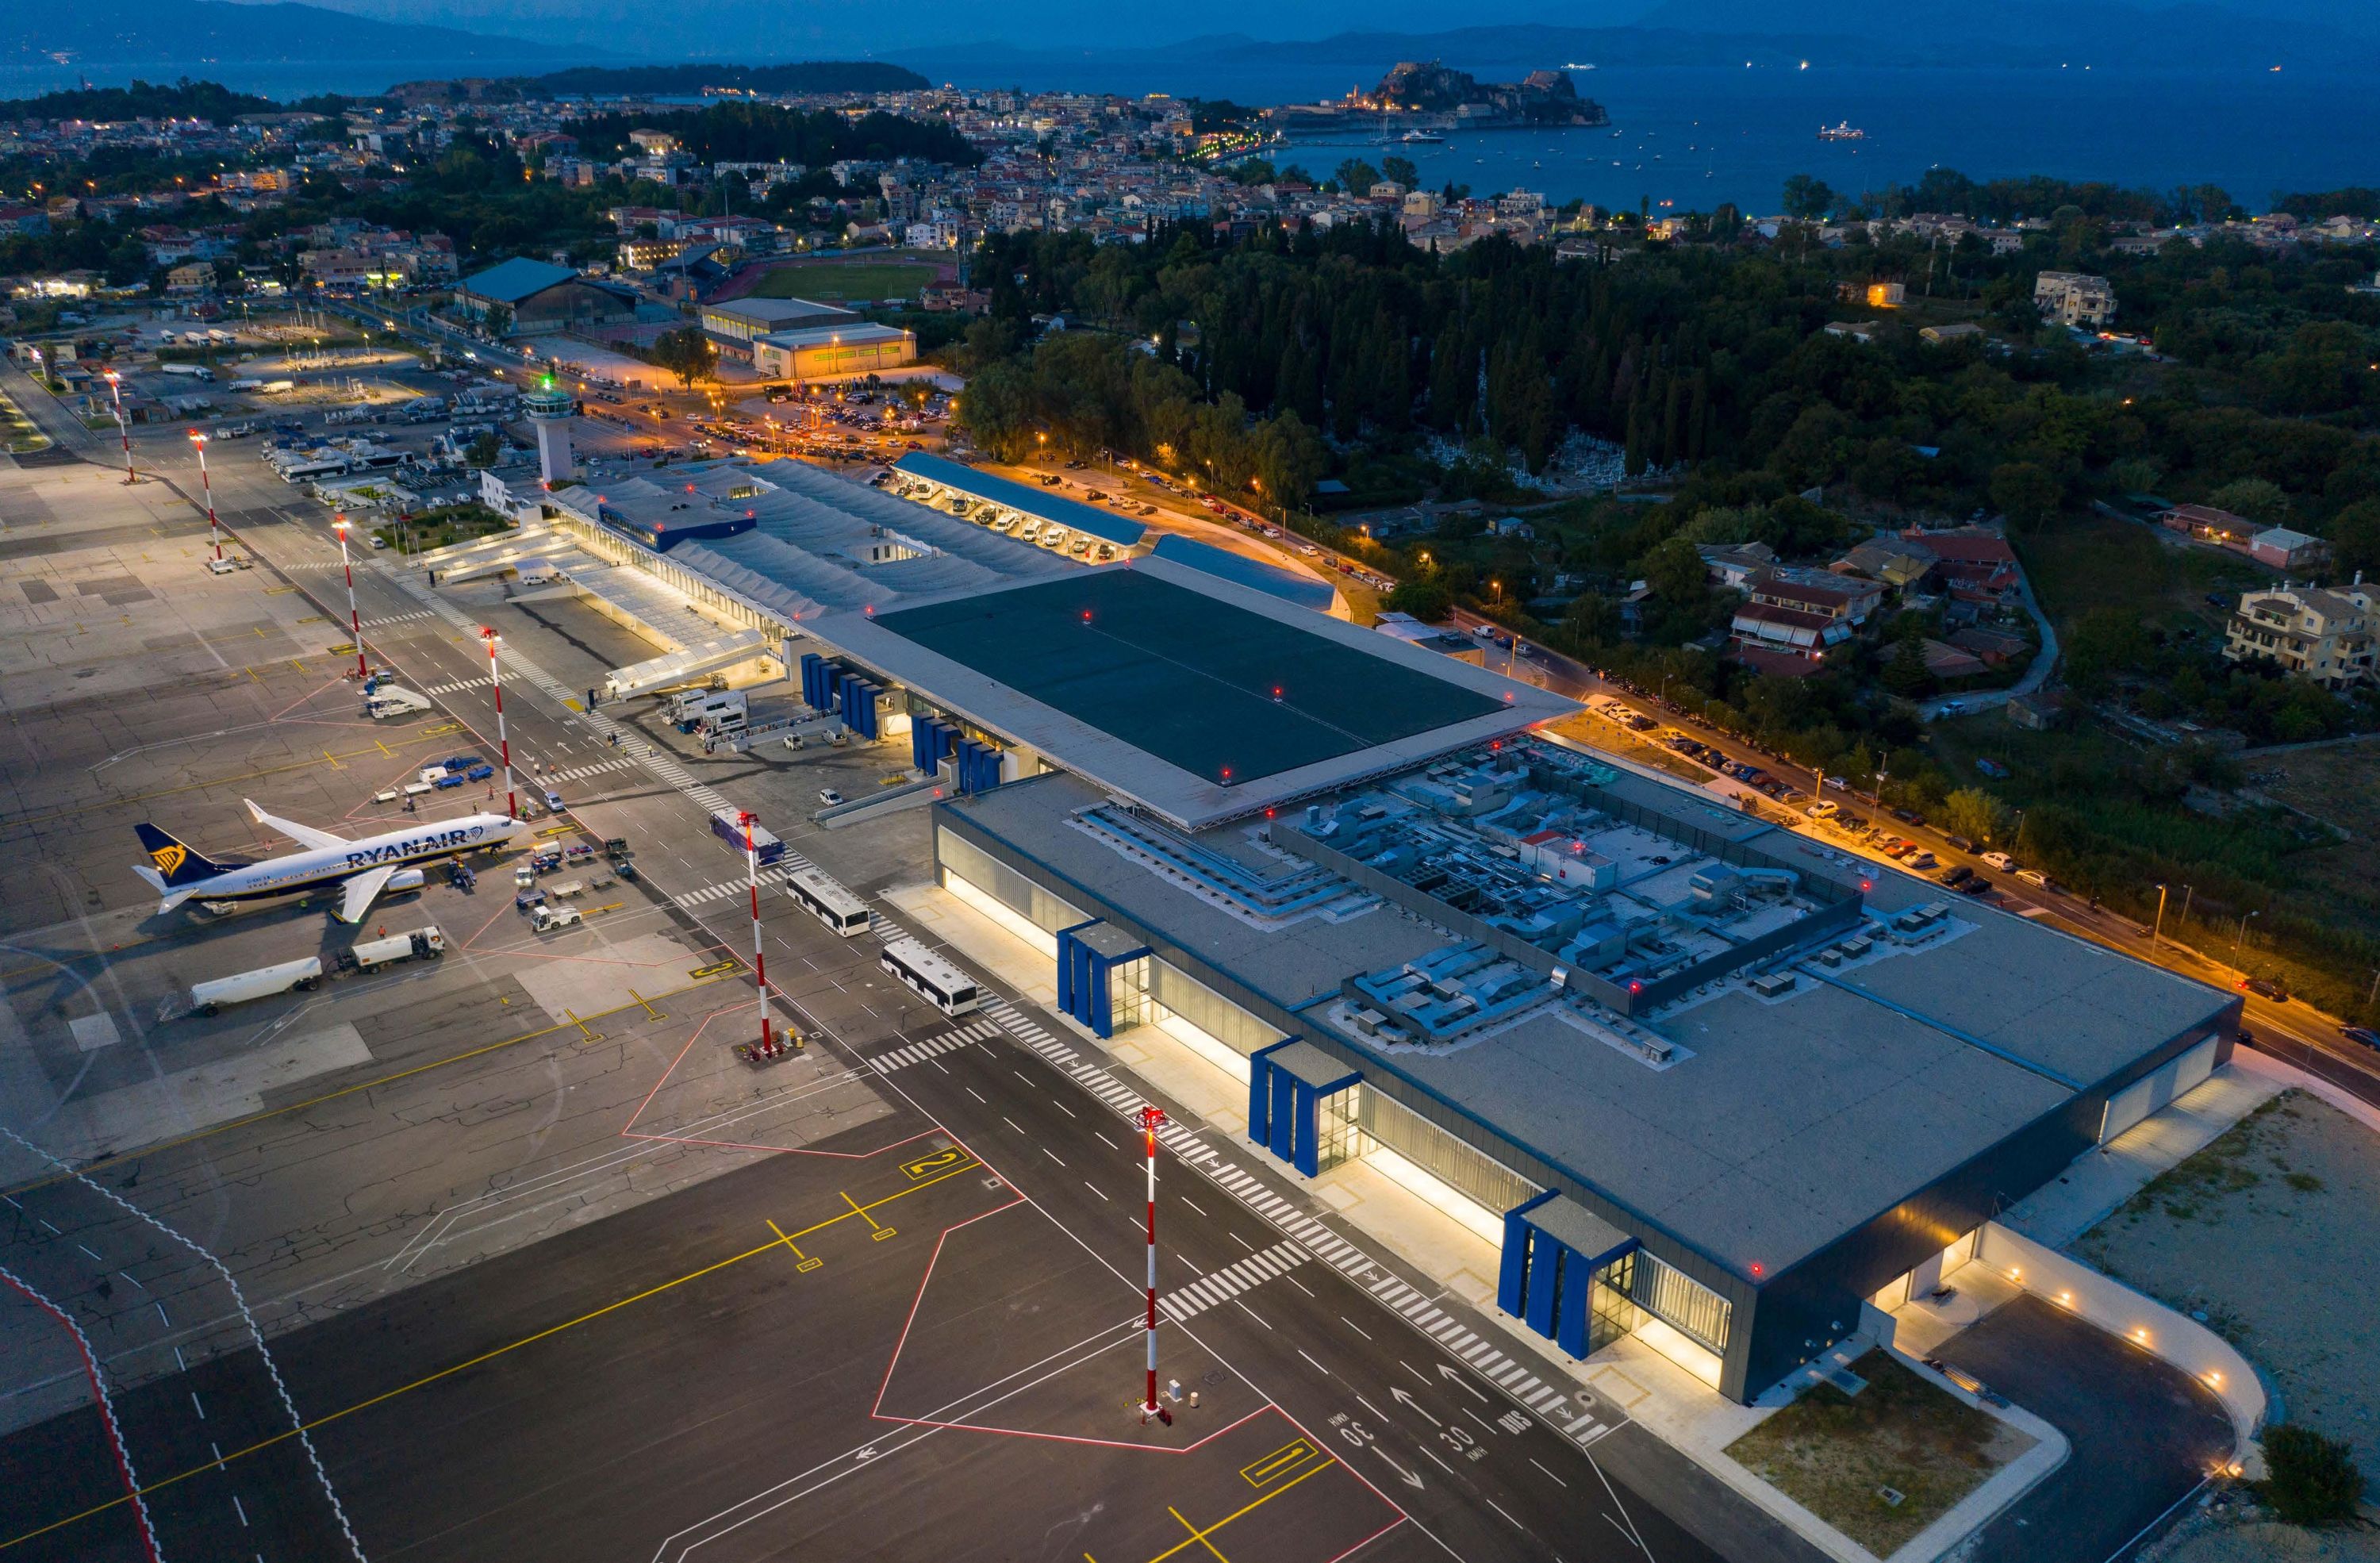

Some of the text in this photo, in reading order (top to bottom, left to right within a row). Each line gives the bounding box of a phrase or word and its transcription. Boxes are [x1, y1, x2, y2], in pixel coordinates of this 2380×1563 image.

[346, 829, 467, 869] RYANAIR
[694, 962, 734, 976] 3
[910, 1153, 957, 1174] 2
[1327, 1411, 1349, 1427] KM/H
[1497, 1410, 1533, 1435] BUS
[1340, 1422, 1375, 1447] 30
[1439, 1427, 1475, 1452] 30
[1255, 1447, 1305, 1477] 1
[1465, 1446, 1488, 1461] KM/H
